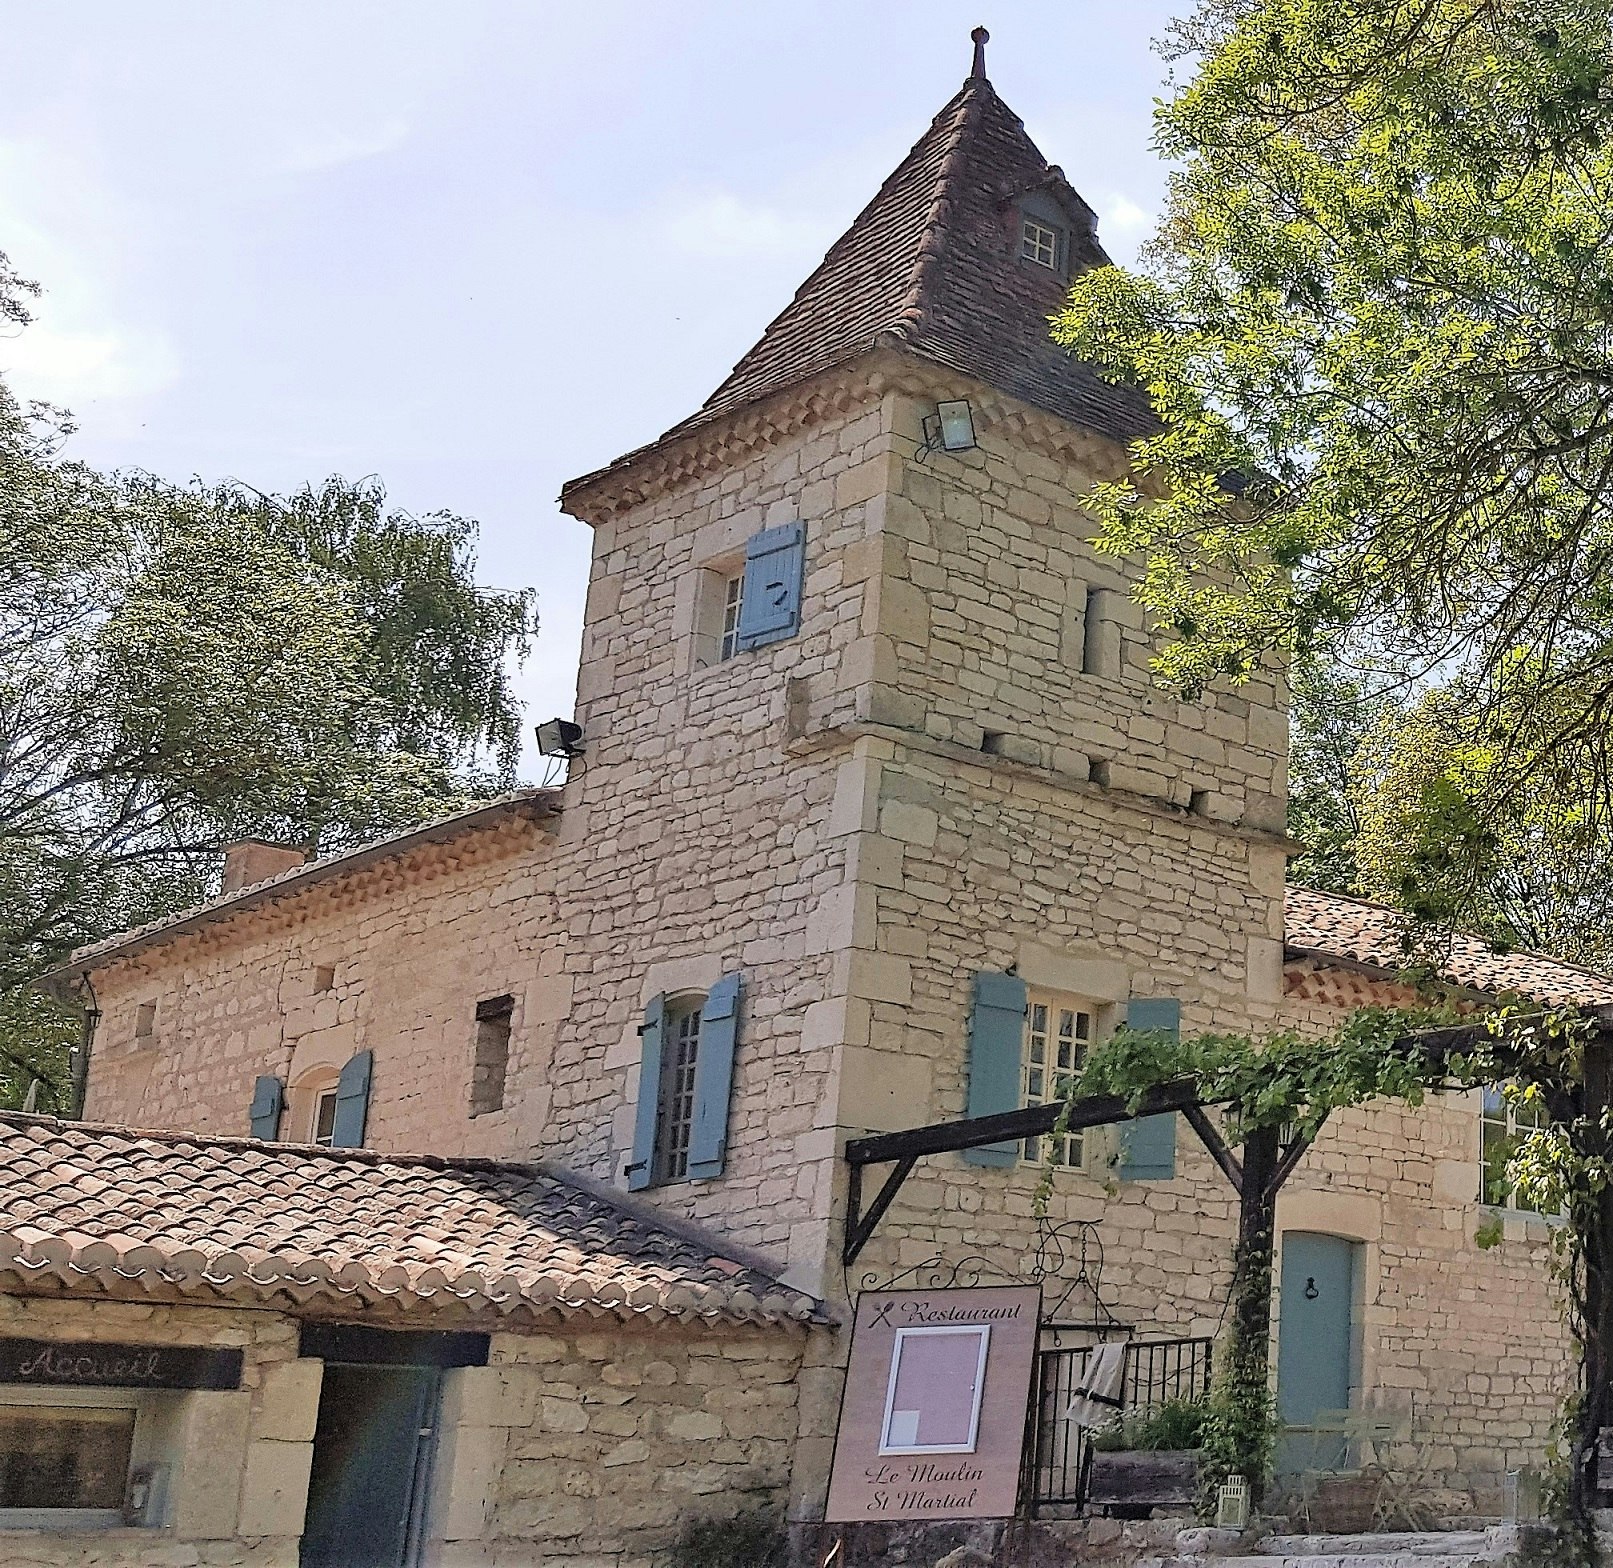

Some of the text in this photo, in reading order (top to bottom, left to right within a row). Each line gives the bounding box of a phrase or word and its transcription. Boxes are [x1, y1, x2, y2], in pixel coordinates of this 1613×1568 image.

[901, 1301, 1021, 1323] Restaurant
[19, 1349, 162, 1380] Accueil
[865, 1462, 984, 1484] Le Moulin
[866, 1488, 977, 1511] St Martial
